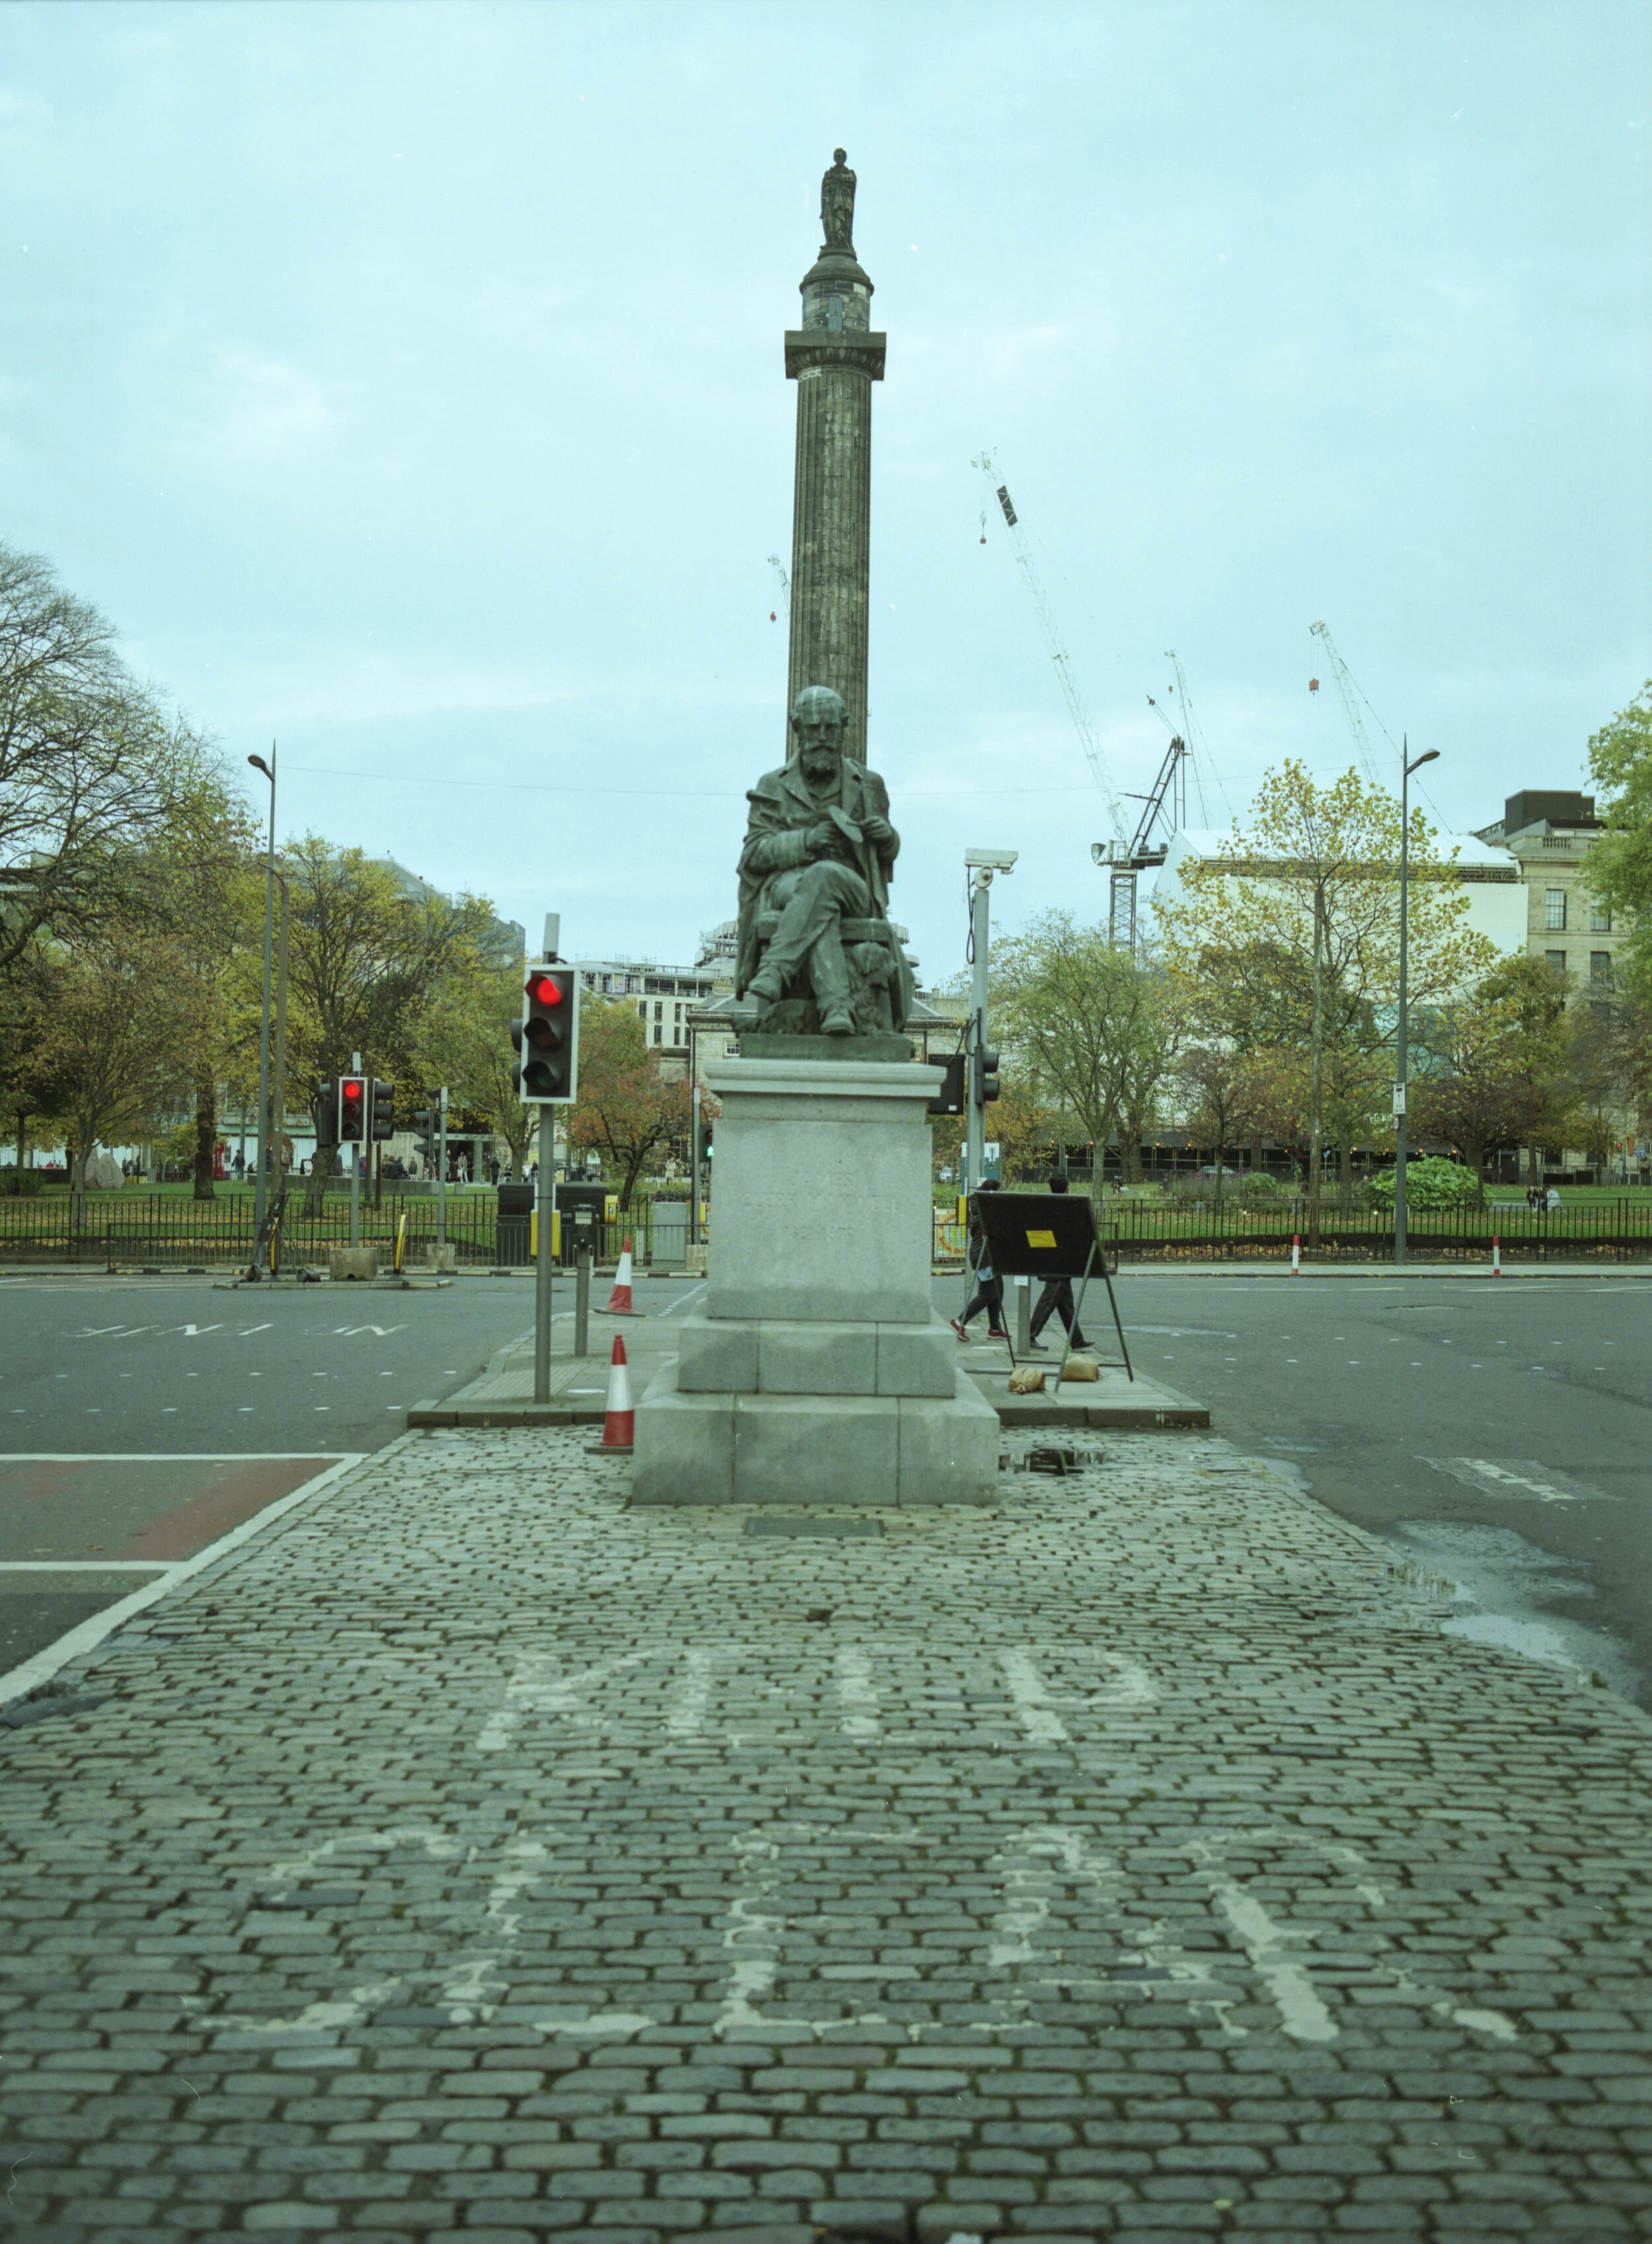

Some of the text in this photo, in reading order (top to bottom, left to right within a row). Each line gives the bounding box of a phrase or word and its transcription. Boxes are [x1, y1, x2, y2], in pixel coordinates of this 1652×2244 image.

[790, 1170, 854, 1188] JAMES
[741, 1191, 901, 1212] CLERK MAXWELL
